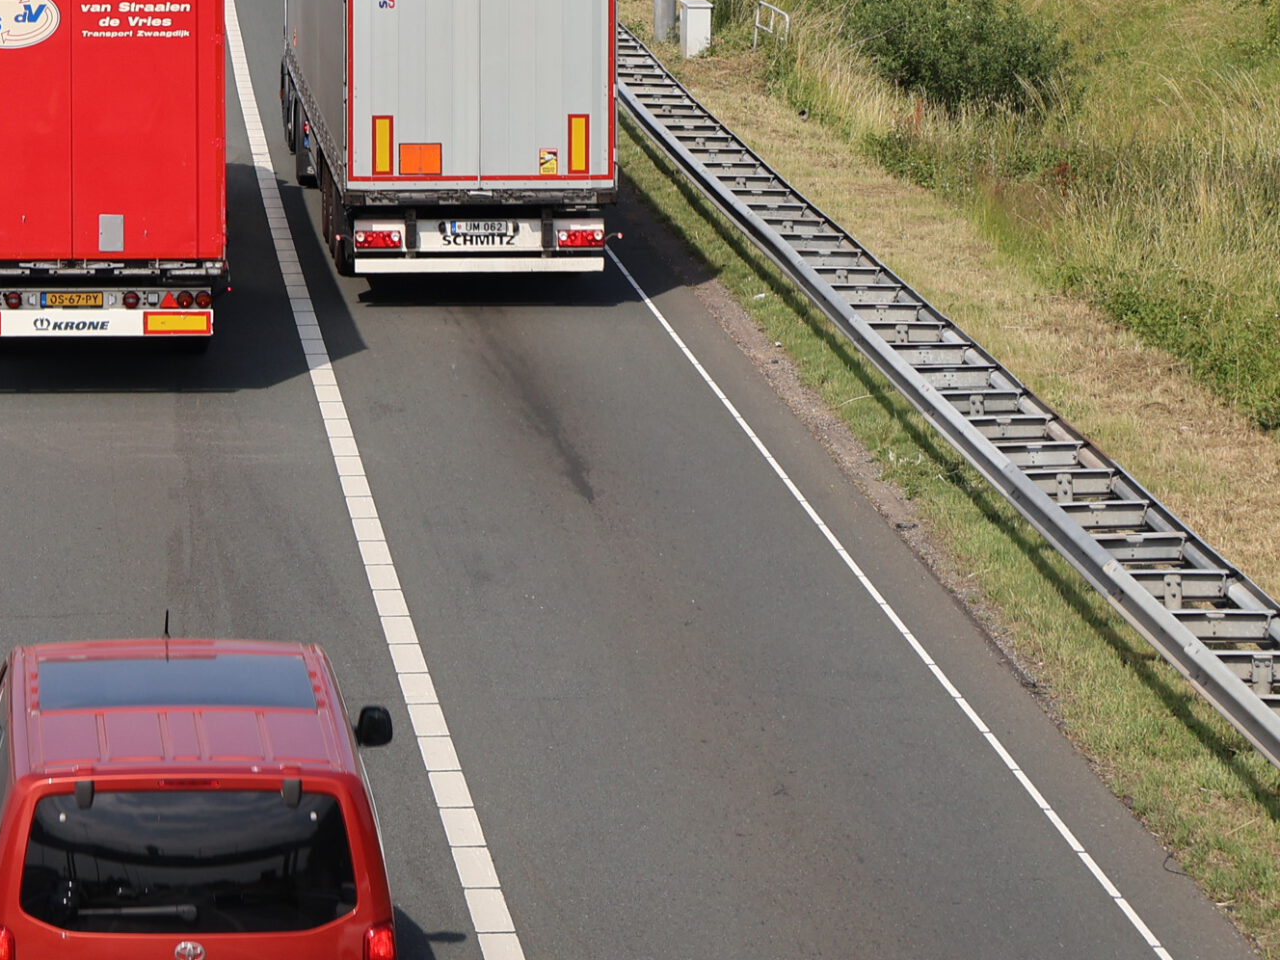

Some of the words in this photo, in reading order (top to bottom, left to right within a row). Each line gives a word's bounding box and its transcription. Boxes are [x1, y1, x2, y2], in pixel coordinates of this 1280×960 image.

[81, 3, 111, 12] van
[118, 2, 191, 13] Straalen
[98, 16, 120, 27] de
[128, 16, 172, 27] Vries
[137, 30, 190, 38] Zwaagdijk
[465, 222, 480, 232] UM
[484, 222, 502, 232] 062
[443, 234, 515, 246] SCHMITZ
[49, 294, 99, 305] OS-67-PY
[52, 321, 110, 330] KRONE
